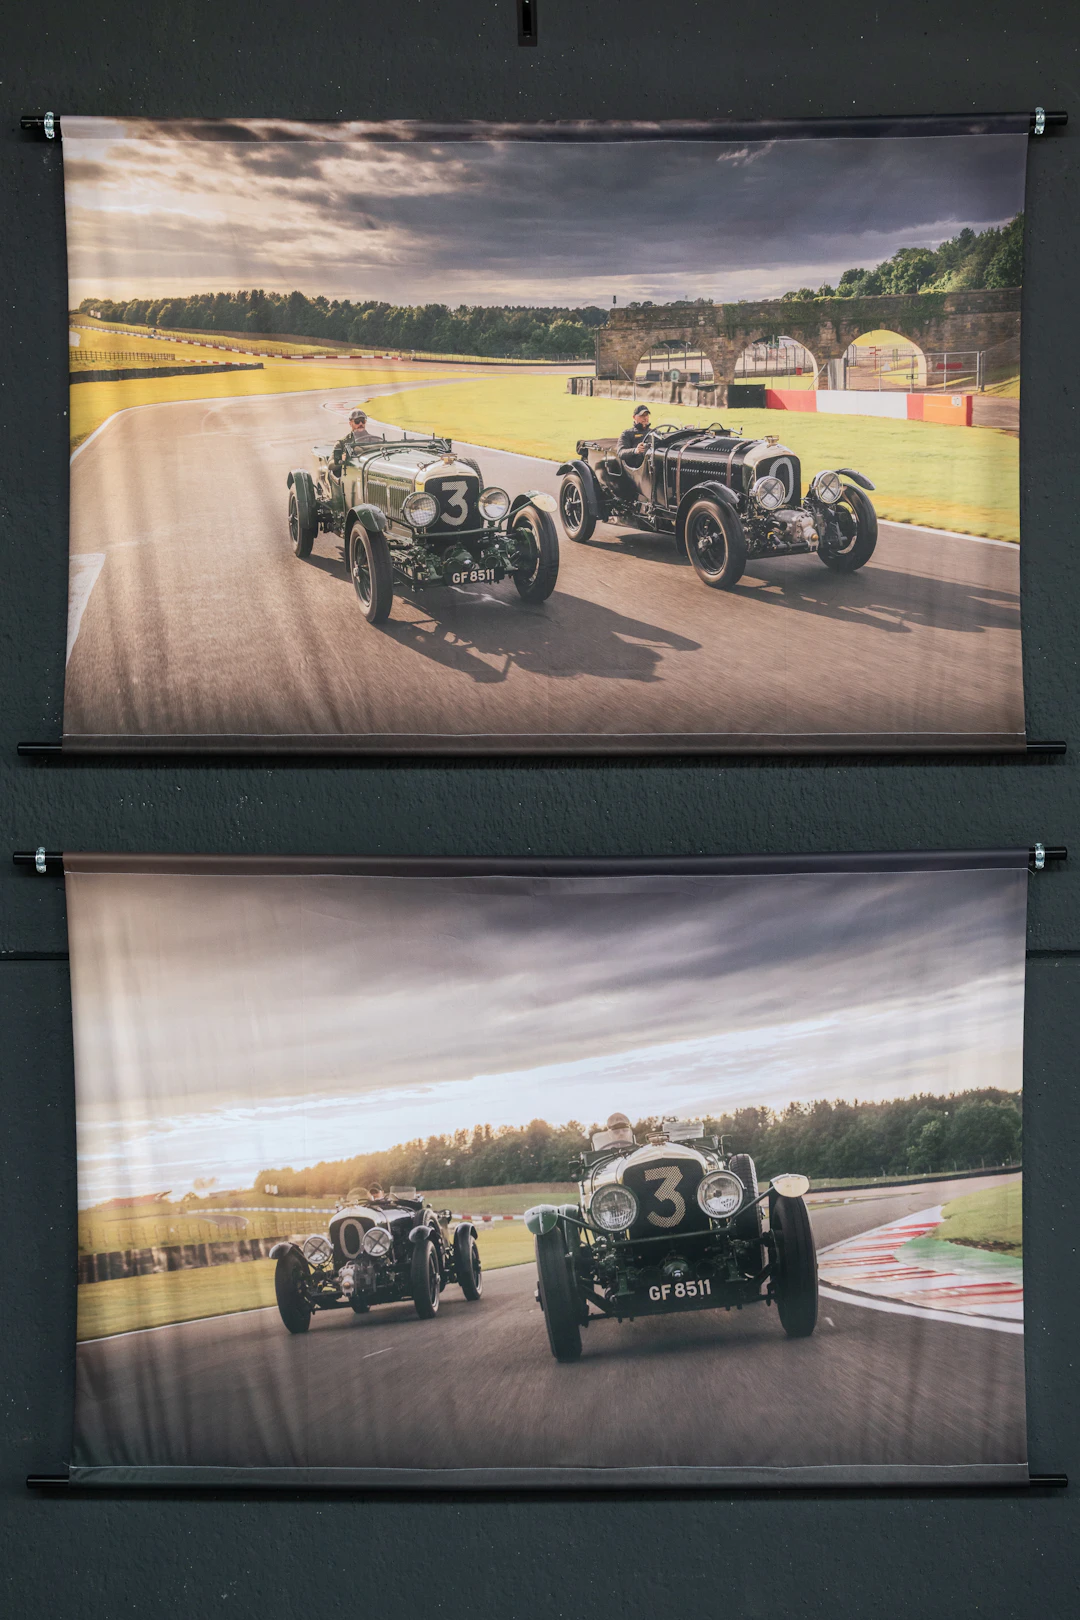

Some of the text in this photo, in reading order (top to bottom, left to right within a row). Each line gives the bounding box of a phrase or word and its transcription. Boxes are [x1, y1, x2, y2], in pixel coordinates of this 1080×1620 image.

[440, 480, 468, 526] 3
[452, 568, 495, 584] GF 8511
[644, 1165, 686, 1228] 3
[339, 1218, 365, 1259] 0
[649, 1279, 711, 1301] GF 8511
